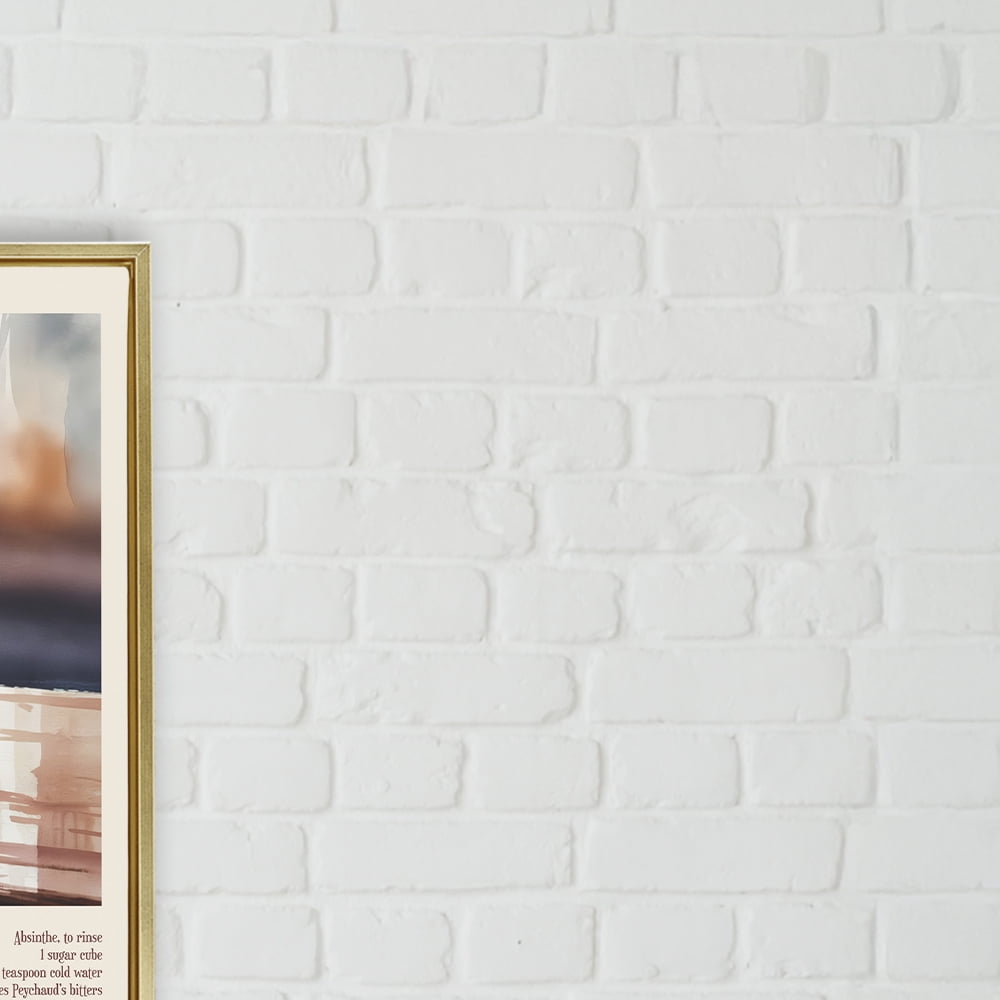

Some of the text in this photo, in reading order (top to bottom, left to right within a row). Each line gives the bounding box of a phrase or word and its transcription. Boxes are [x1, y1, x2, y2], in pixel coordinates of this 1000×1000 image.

[64, 932, 73, 944] to
[77, 931, 103, 943] rinse
[40, 948, 103, 963] 1 sugar cube
[2, 967, 46, 981] teaspoon
[50, 966, 70, 978] cold
[74, 967, 103, 979] water
[12, 983, 66, 998] Peychaud's
[70, 983, 103, 997] bitters
